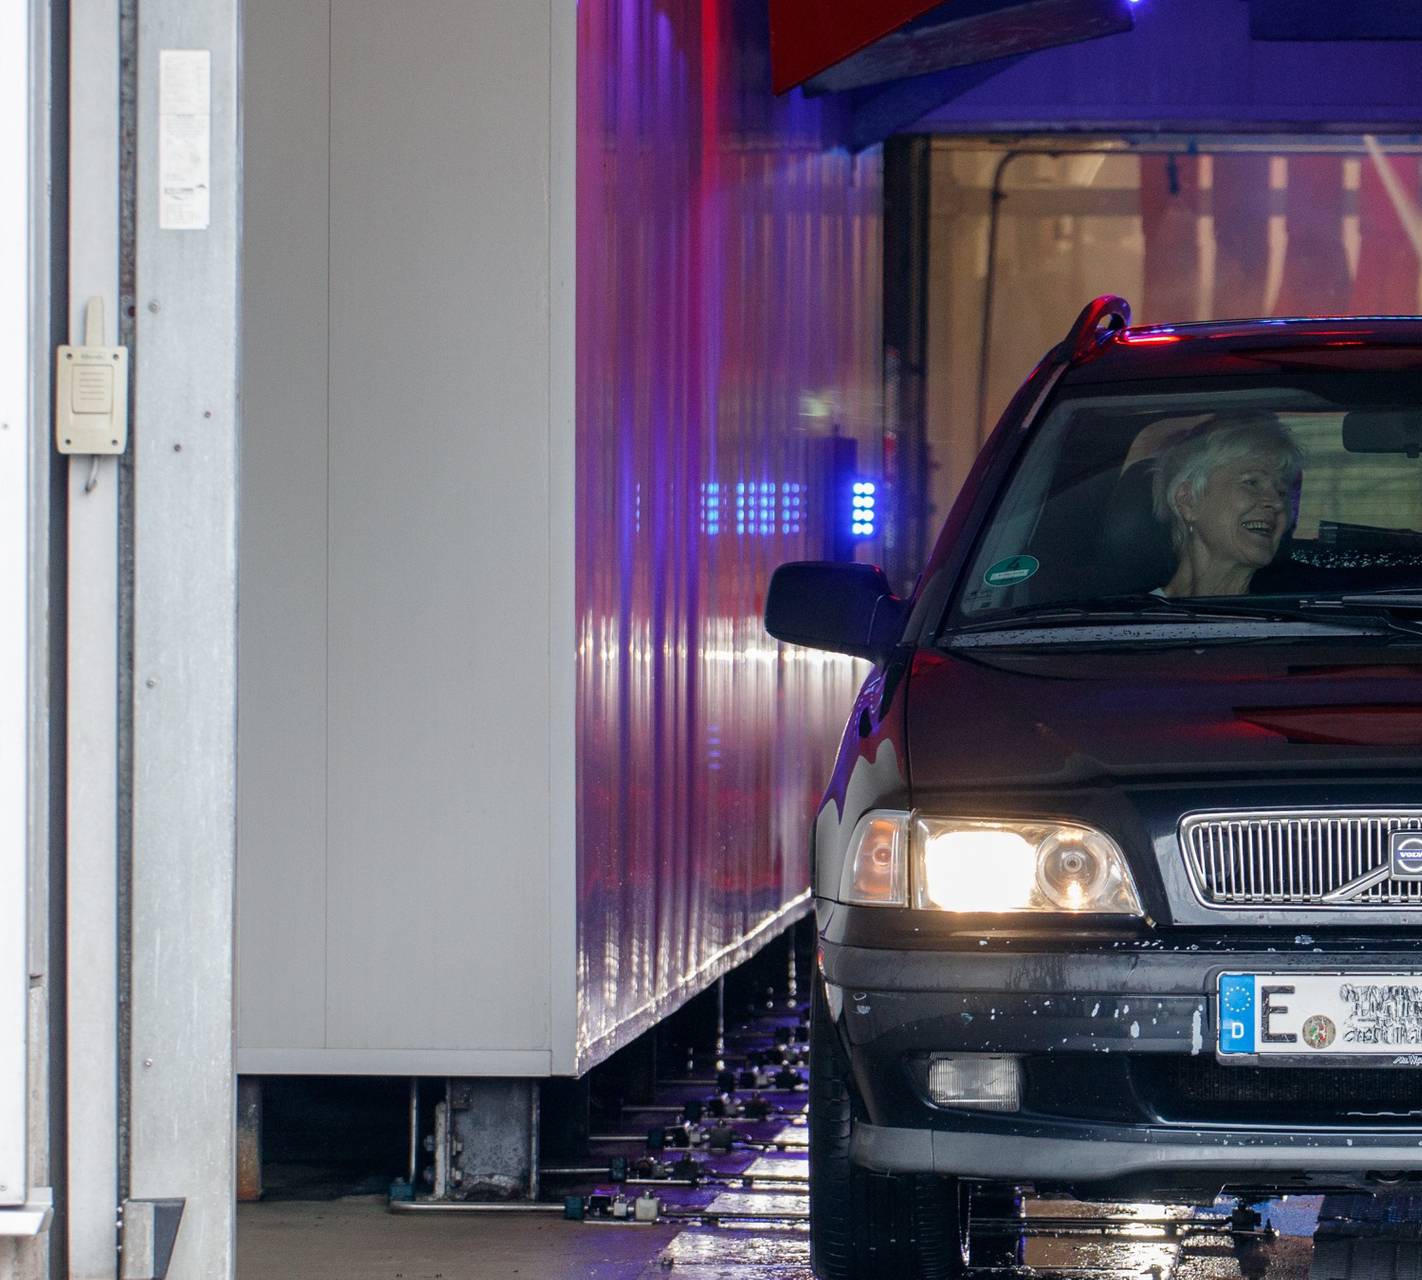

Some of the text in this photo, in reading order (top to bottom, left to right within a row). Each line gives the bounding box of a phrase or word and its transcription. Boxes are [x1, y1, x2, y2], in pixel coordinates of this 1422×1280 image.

[1007, 557, 1020, 570] 4
[1261, 985, 1297, 1043] E
[1231, 1022, 1244, 1039] D
